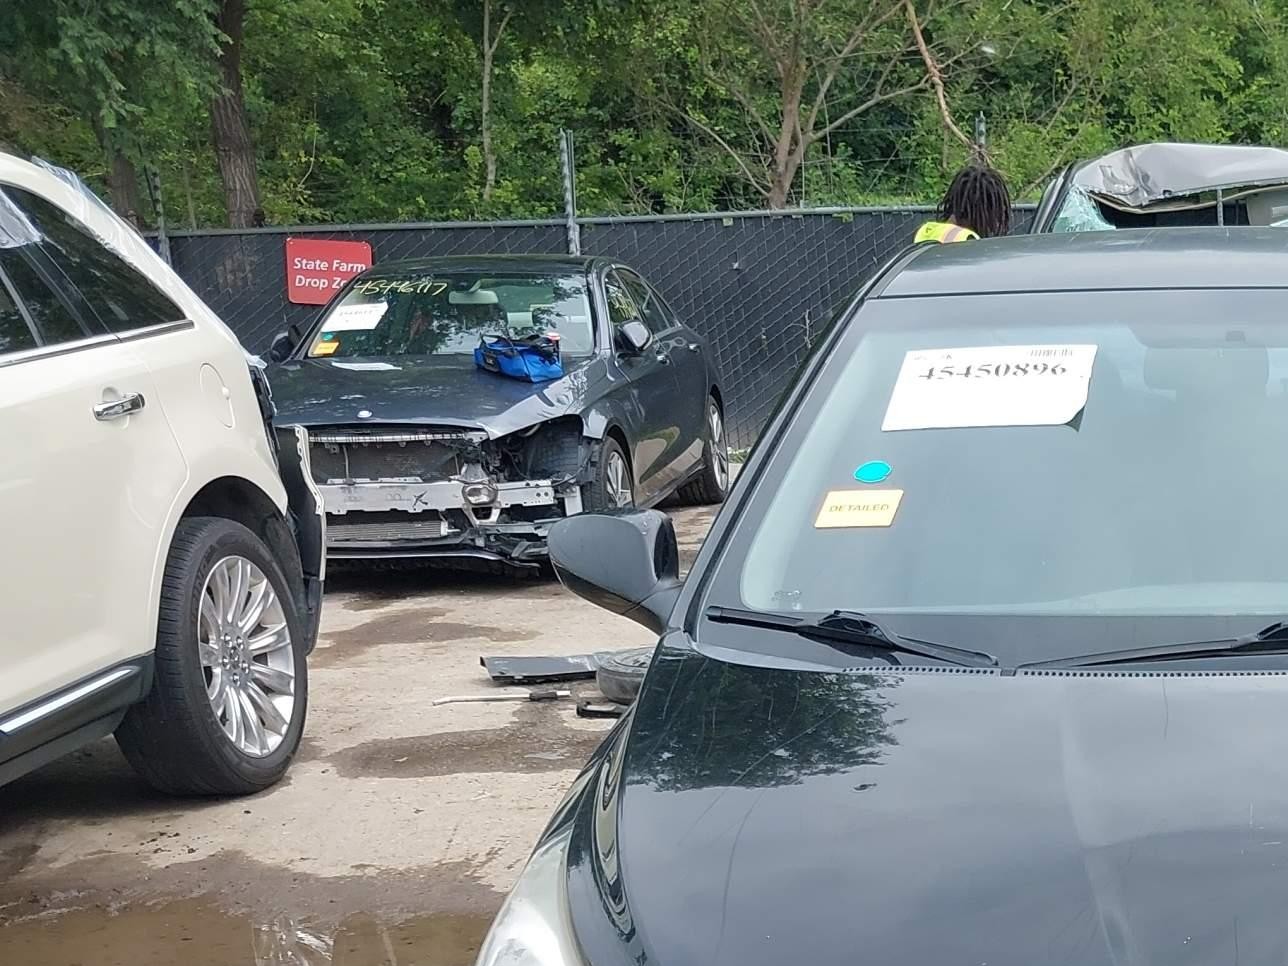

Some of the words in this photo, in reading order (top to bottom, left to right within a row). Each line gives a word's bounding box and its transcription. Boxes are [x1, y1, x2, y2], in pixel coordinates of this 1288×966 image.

[293, 257, 328, 272] State
[332, 260, 366, 273] Farm
[295, 275, 328, 290] Drop
[918, 362, 1067, 380] 45450896
[829, 503, 890, 512] DETAILED
